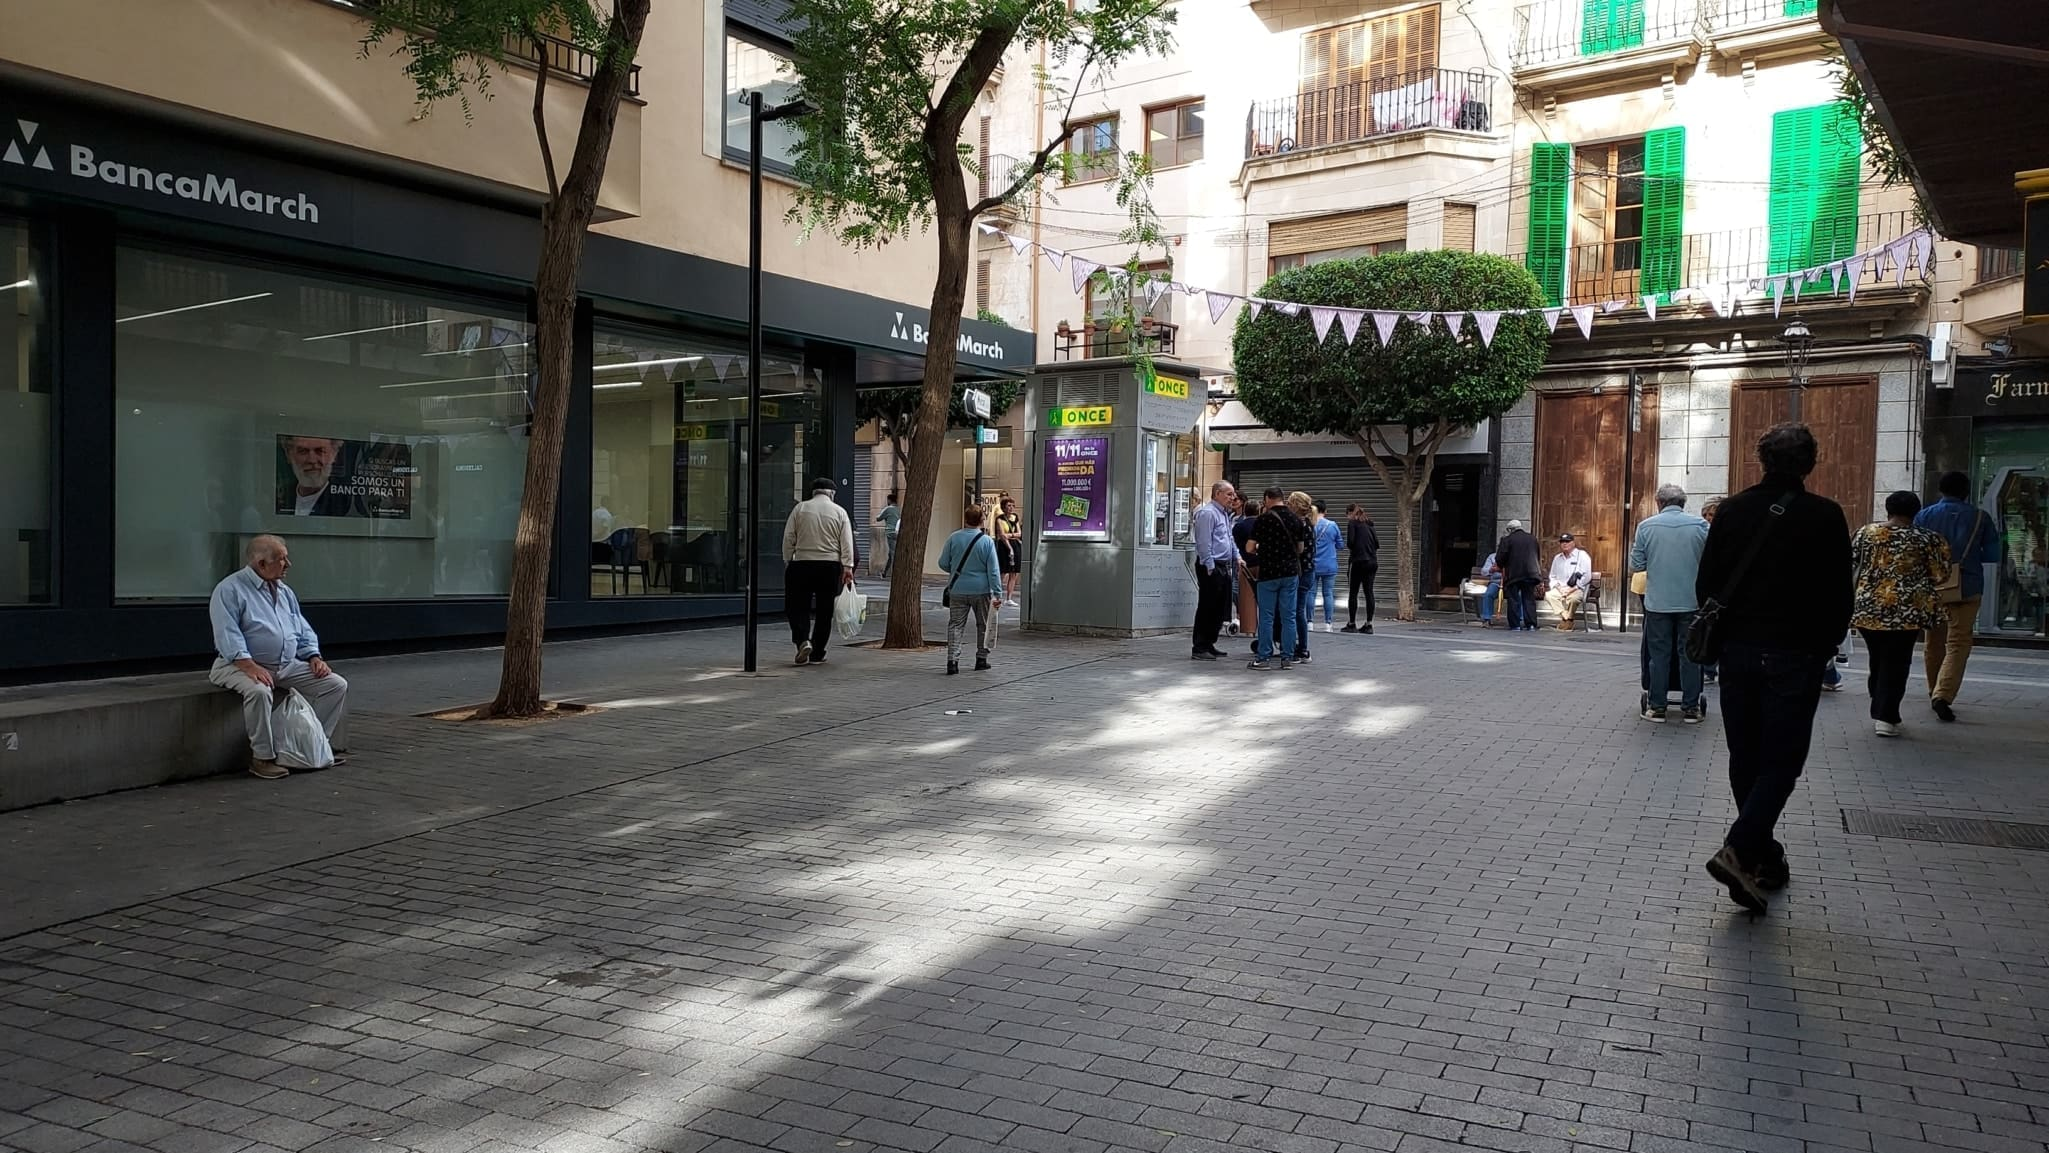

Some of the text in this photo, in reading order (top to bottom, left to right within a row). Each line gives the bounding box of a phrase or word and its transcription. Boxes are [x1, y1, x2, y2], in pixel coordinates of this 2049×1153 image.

[70, 143, 319, 224] BancaMarch
[913, 323, 1004, 360] BaMarch
[1158, 380, 1185, 395] ONCE
[1067, 409, 1107, 423] ONCE
[1055, 443, 1081, 459] 11/11
[1080, 466, 1095, 475] DA
[351, 475, 405, 487] SOMOS UN
[330, 484, 405, 498] BANCO PARA TI
